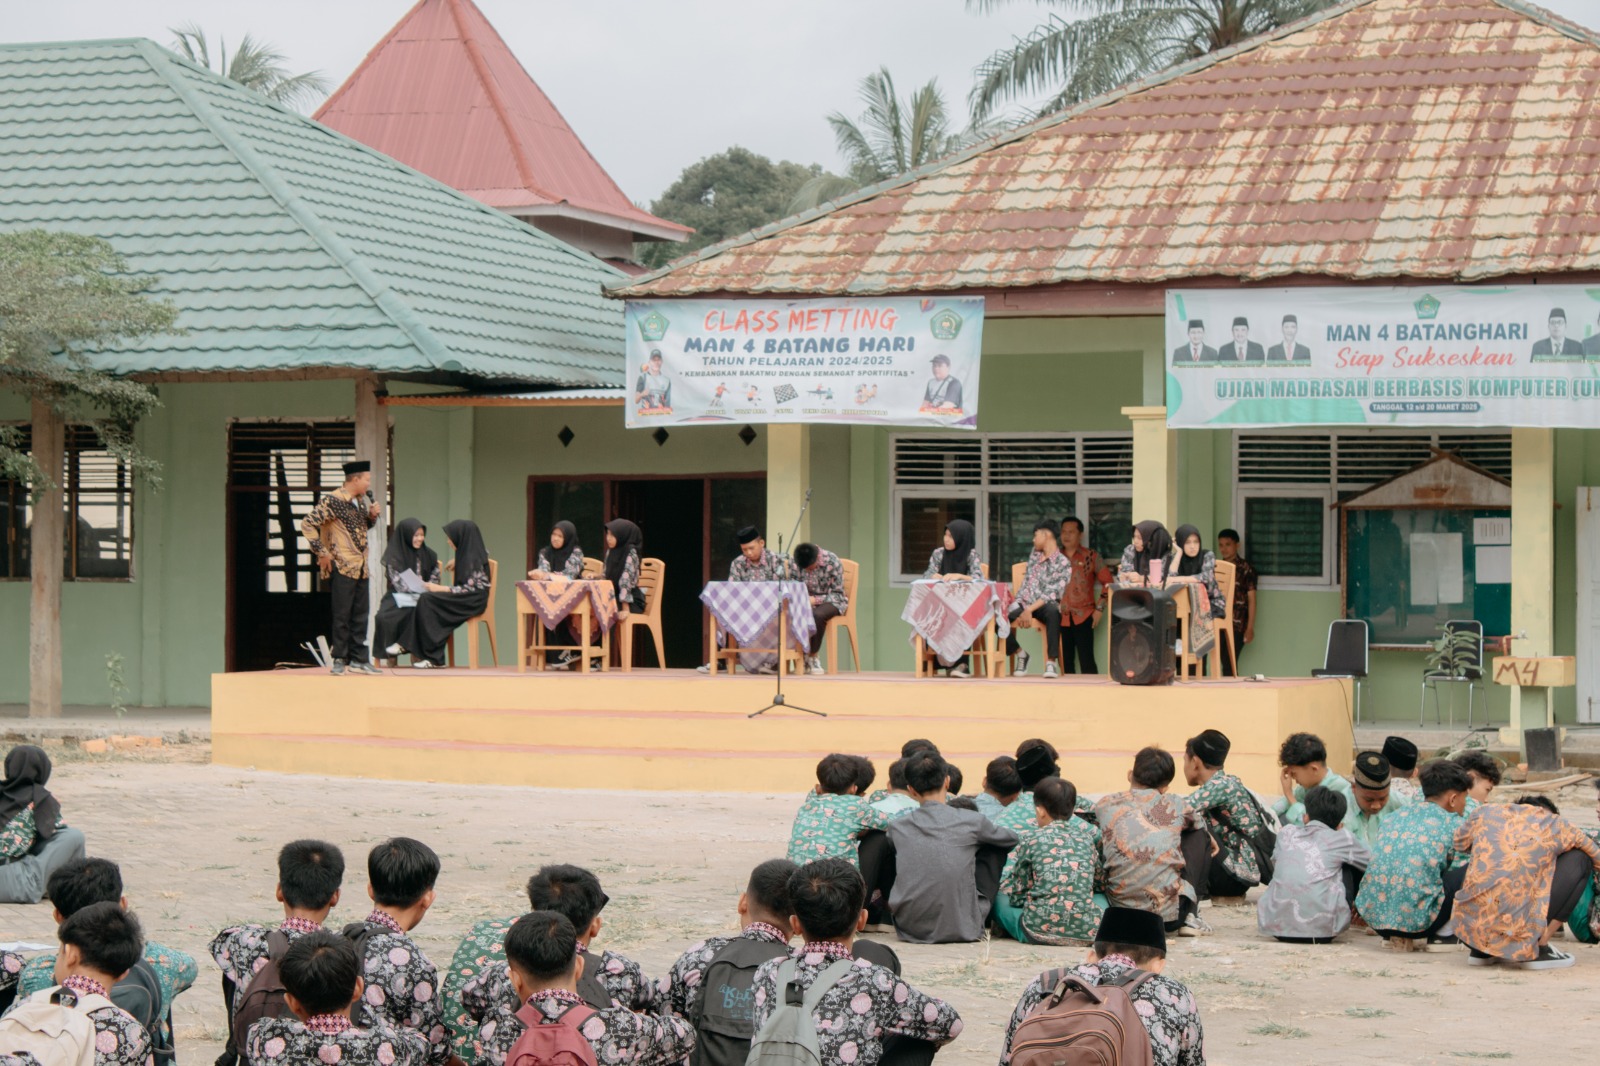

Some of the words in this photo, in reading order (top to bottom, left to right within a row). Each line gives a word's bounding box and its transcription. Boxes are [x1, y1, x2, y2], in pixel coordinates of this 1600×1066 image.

[704, 309, 779, 334] CLASS
[788, 307, 898, 333] METTING
[1326, 324, 1371, 341] MAN
[1377, 324, 1389, 341] 4
[1396, 323, 1528, 341] BATANGHARI
[683, 337, 735, 353] MAN
[743, 338, 755, 353] 4
[764, 337, 850, 353] BATANG
[858, 336, 915, 352] HARI
[702, 356, 745, 366] TAHUN
[749, 356, 825, 366] PELAJARAN
[829, 356, 893, 366] 2024/2025
[1335, 346, 1385, 375] Siap
[1393, 345, 1516, 368] Sukseskan
[857, 369, 908, 377] SPORTIFITAS
[1217, 379, 1265, 398] UJIAN
[1270, 379, 1368, 398] MADRASAH
[1373, 379, 1463, 397] BERBASIS
[1468, 379, 1567, 397] KOMPUTER
[1372, 403, 1404, 411] TANGGAL
[1406, 403, 1414, 411] 12
